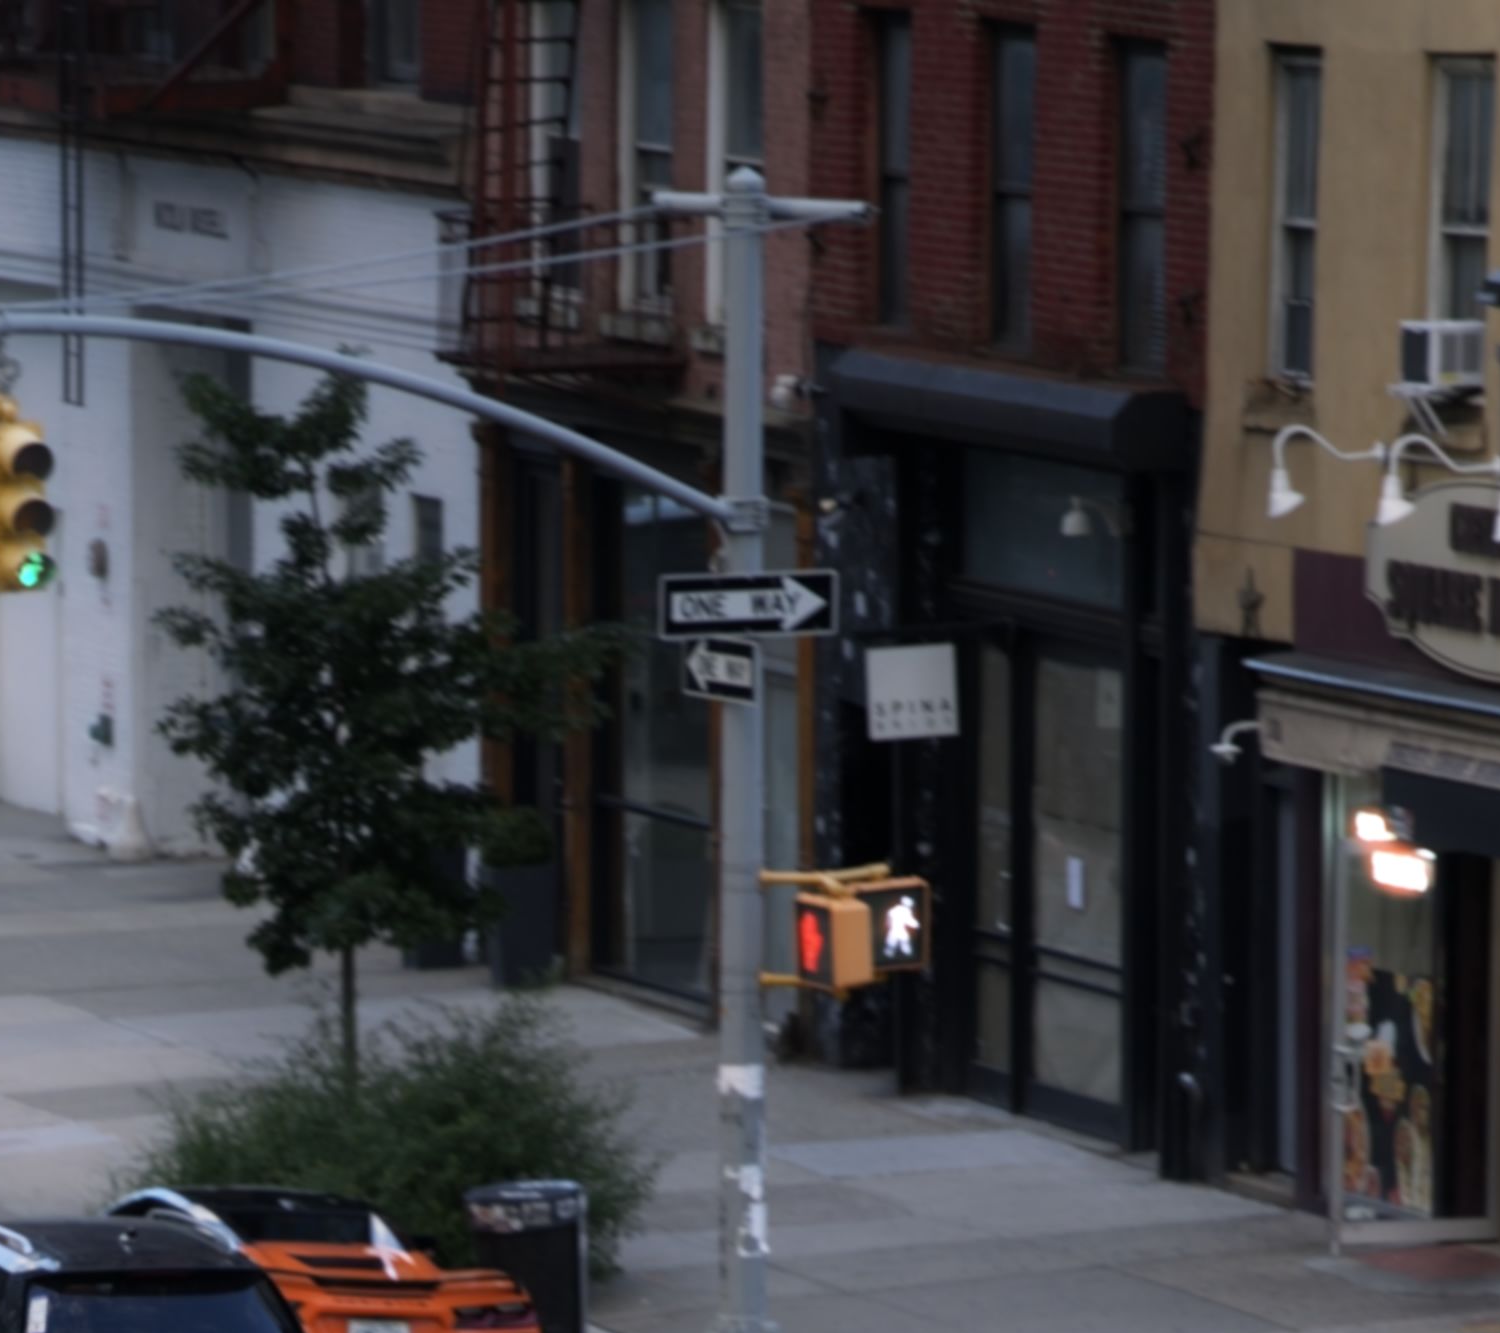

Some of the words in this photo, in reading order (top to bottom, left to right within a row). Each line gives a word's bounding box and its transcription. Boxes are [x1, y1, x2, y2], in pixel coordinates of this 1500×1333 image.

[680, 595, 726, 617] ONE
[752, 591, 802, 614] WAY
[875, 698, 951, 717] SPINA
